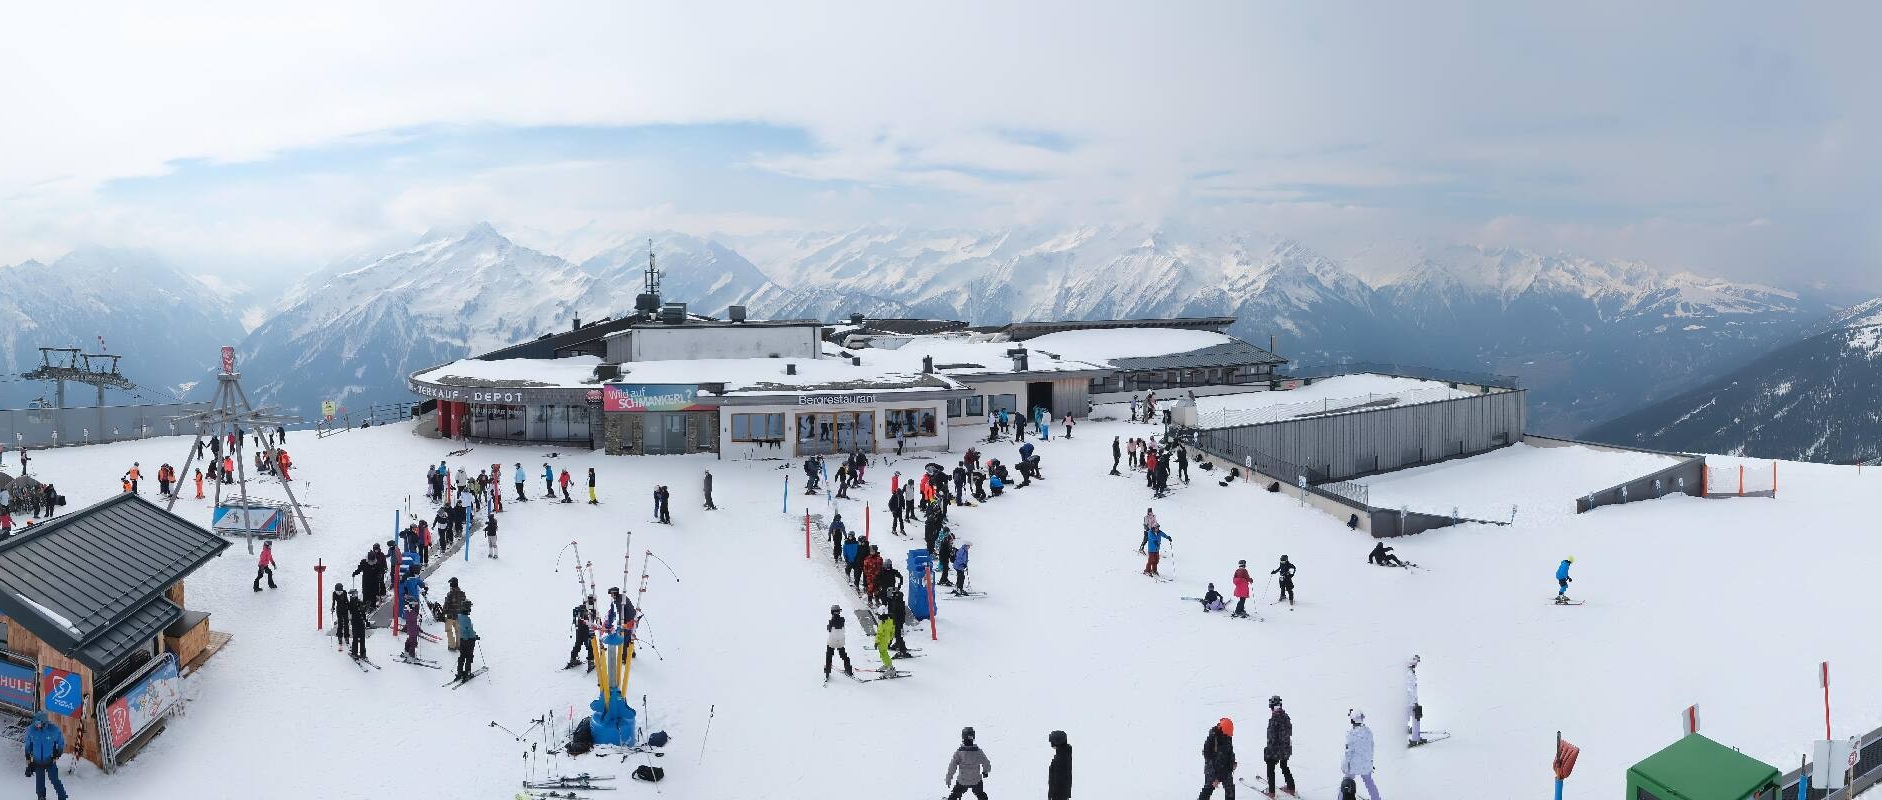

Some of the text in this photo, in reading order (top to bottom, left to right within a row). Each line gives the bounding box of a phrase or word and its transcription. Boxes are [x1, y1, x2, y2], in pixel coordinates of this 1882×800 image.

[474, 392, 523, 402] DEPOT
[608, 390, 629, 400] Wild
[630, 387, 646, 398] auf
[798, 394, 876, 405] Bergrestaurant
